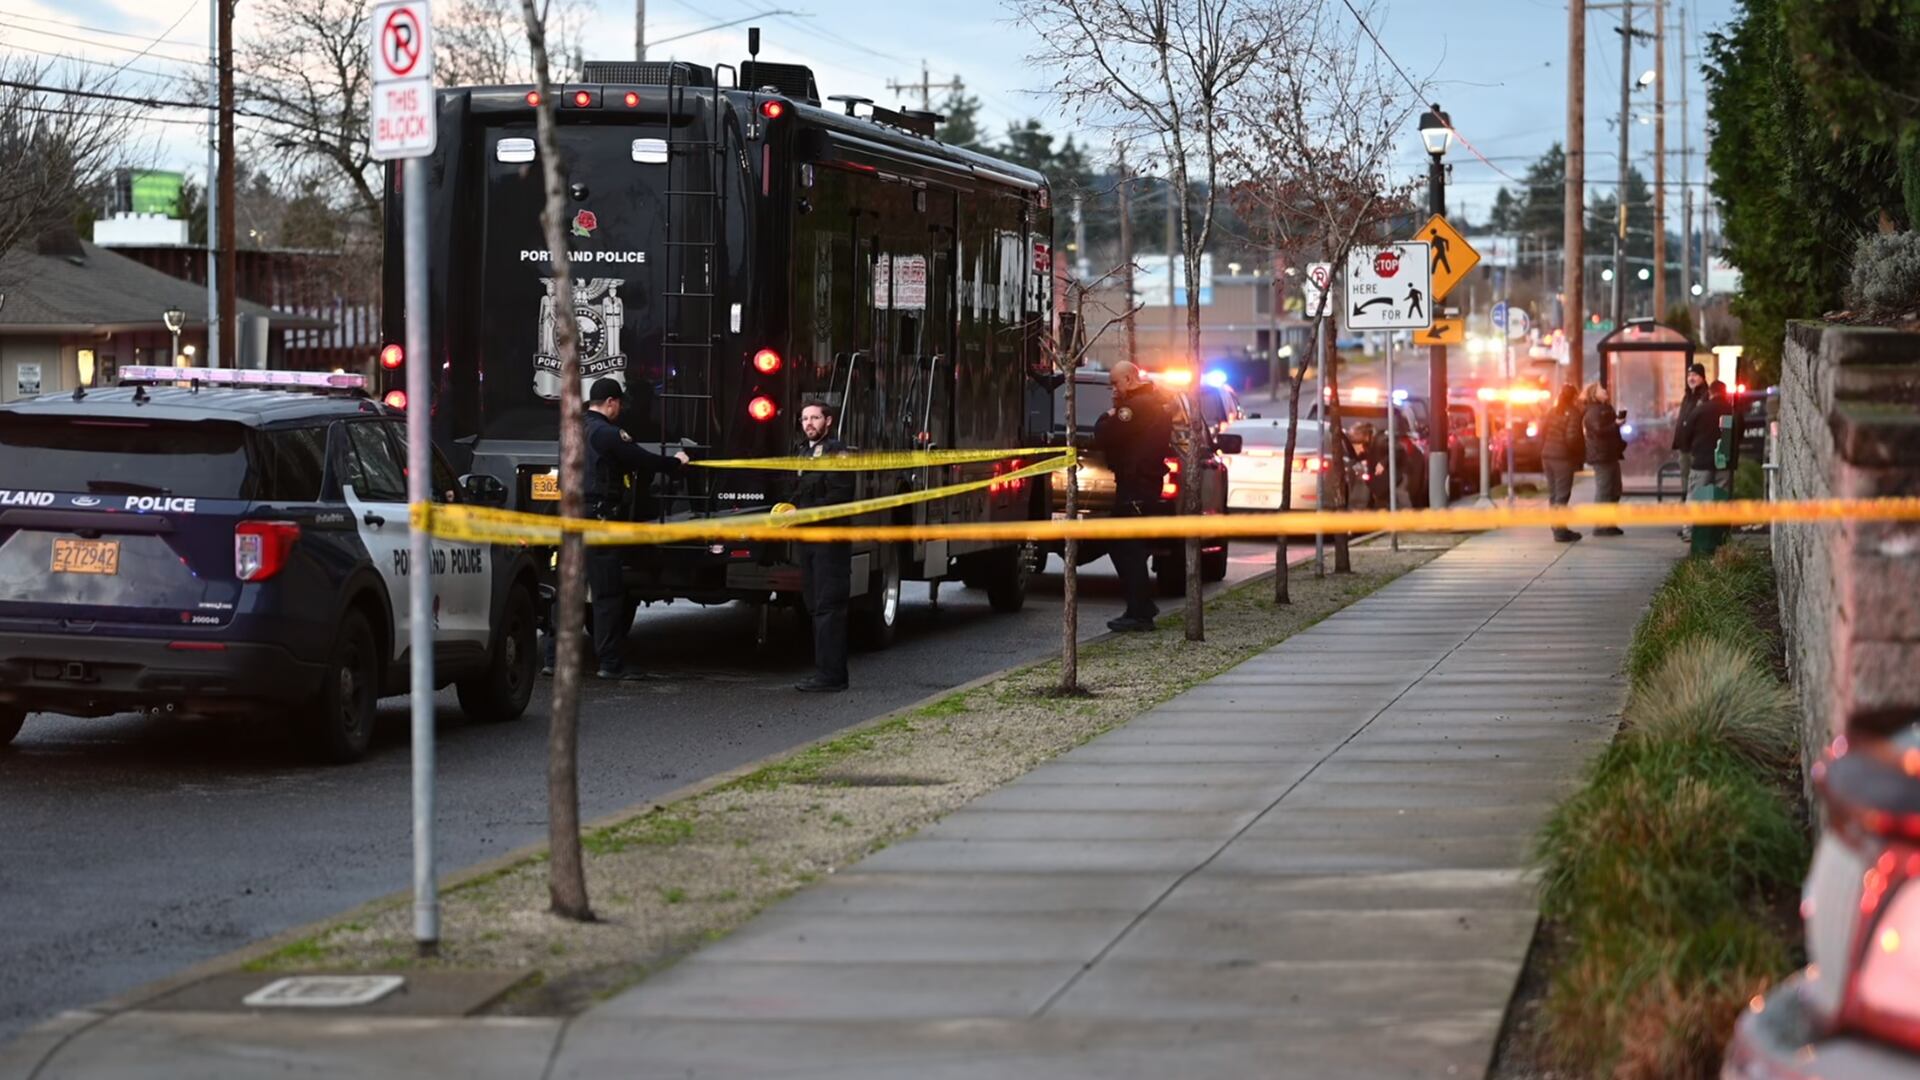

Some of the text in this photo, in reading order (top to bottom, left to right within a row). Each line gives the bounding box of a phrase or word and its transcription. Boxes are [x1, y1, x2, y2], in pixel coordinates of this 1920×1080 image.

[386, 89, 418, 112] THIS
[379, 117, 427, 140] BLOCK
[520, 250, 645, 263] PORTAND POLICE
[1352, 284, 1378, 294] HERE
[1382, 309, 1401, 320] FOR
[537, 357, 623, 373] PORTD POLICE
[125, 496, 196, 512] POLICE
[56, 547, 115, 565] E272942
[451, 549, 482, 574] POLICE
